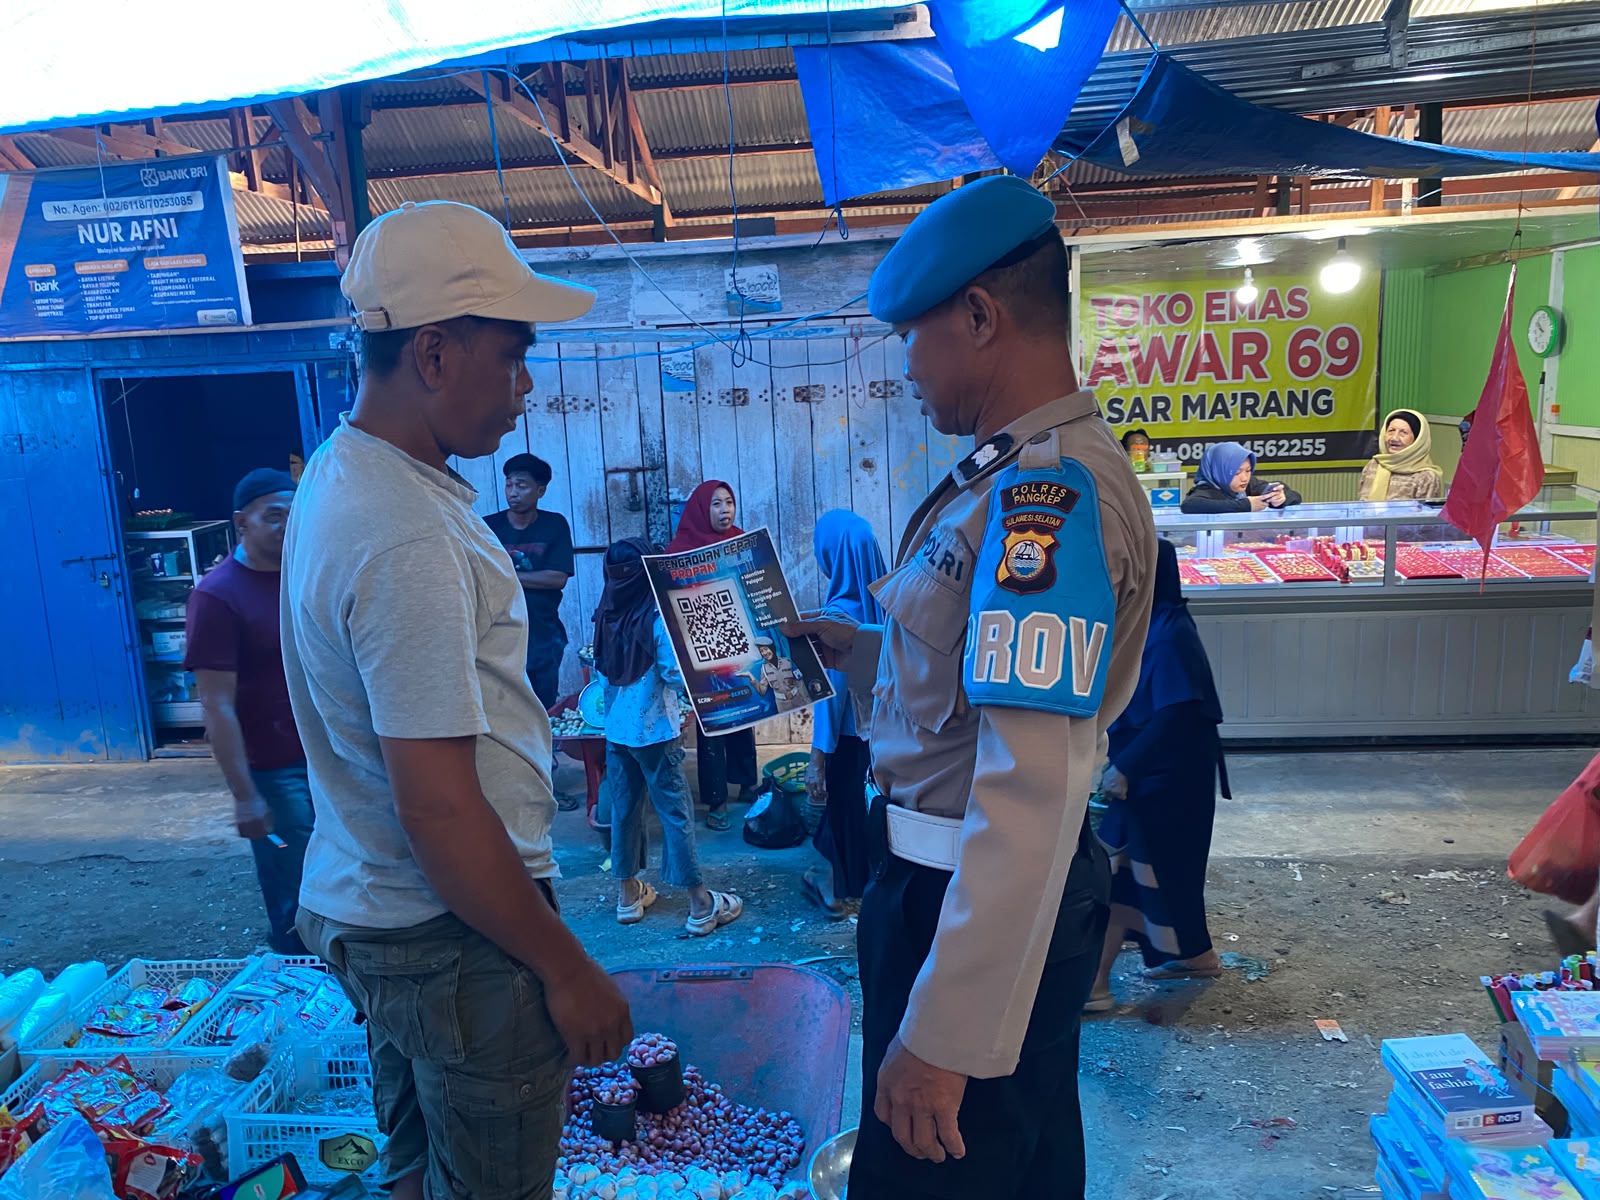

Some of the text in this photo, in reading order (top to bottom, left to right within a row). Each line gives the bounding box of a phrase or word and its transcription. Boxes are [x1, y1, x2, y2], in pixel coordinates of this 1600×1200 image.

[157, 166, 208, 182] BANK BRI
[53, 205, 70, 215] No.
[72, 202, 101, 216] Agen:
[78, 217, 179, 244] NUR AFNI
[1091, 287, 1310, 329] TOKO EMAS
[1079, 324, 1362, 389] AWAR 69
[1180, 387, 1335, 423] MA'RANG
[1012, 483, 1067, 498] POLRES
[1013, 493, 1062, 505] PANGKEP
[1006, 514, 1062, 527] SULAWESI SELATAN
[658, 535, 758, 571] PENGADUAN CEPAT
[671, 562, 718, 581] PROPAM
[759, 613, 772, 622] Bukti
[760, 616, 788, 627] Pendukung
[1419, 1071, 1454, 1080] I am
